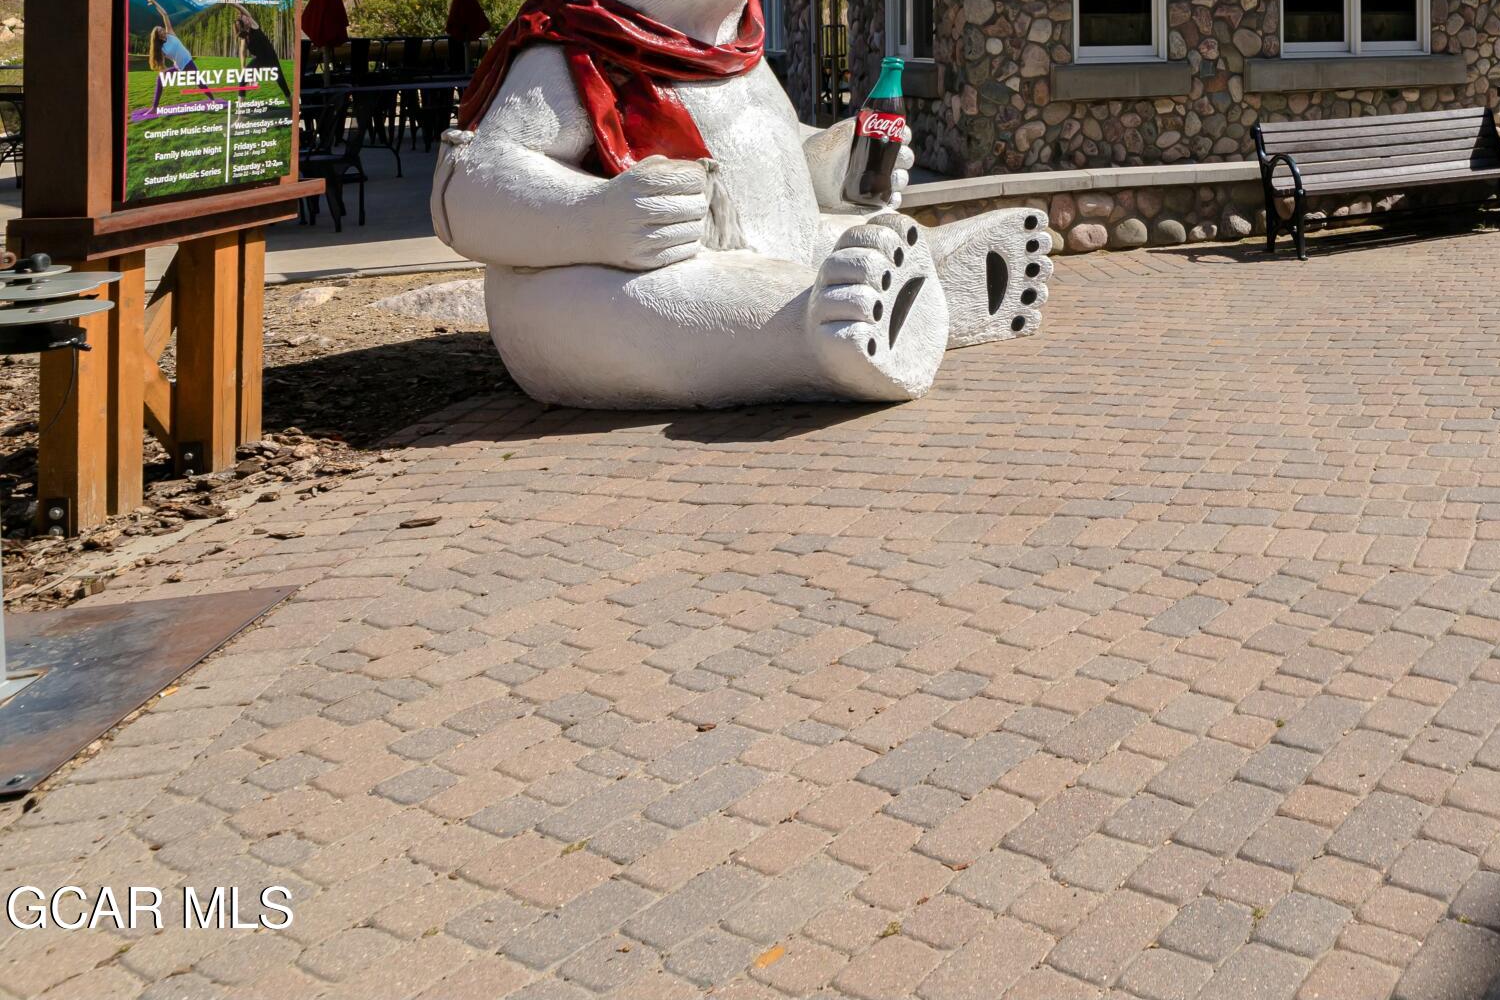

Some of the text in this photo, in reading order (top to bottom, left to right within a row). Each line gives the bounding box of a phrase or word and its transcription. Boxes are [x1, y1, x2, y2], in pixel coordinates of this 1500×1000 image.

[160, 67, 279, 88] WEEKLY EVENTS
[156, 102, 224, 115] Mountainside Yoga
[235, 99, 265, 108] Tuesdays
[144, 123, 223, 139] Campfire Music Series
[234, 120, 274, 130] Wednesdays
[233, 139, 277, 151] Fridays Dusk
[154, 145, 222, 160] Family Movie Night
[232, 162, 261, 172] Saturday
[143, 167, 222, 186] Saturday Music Series
